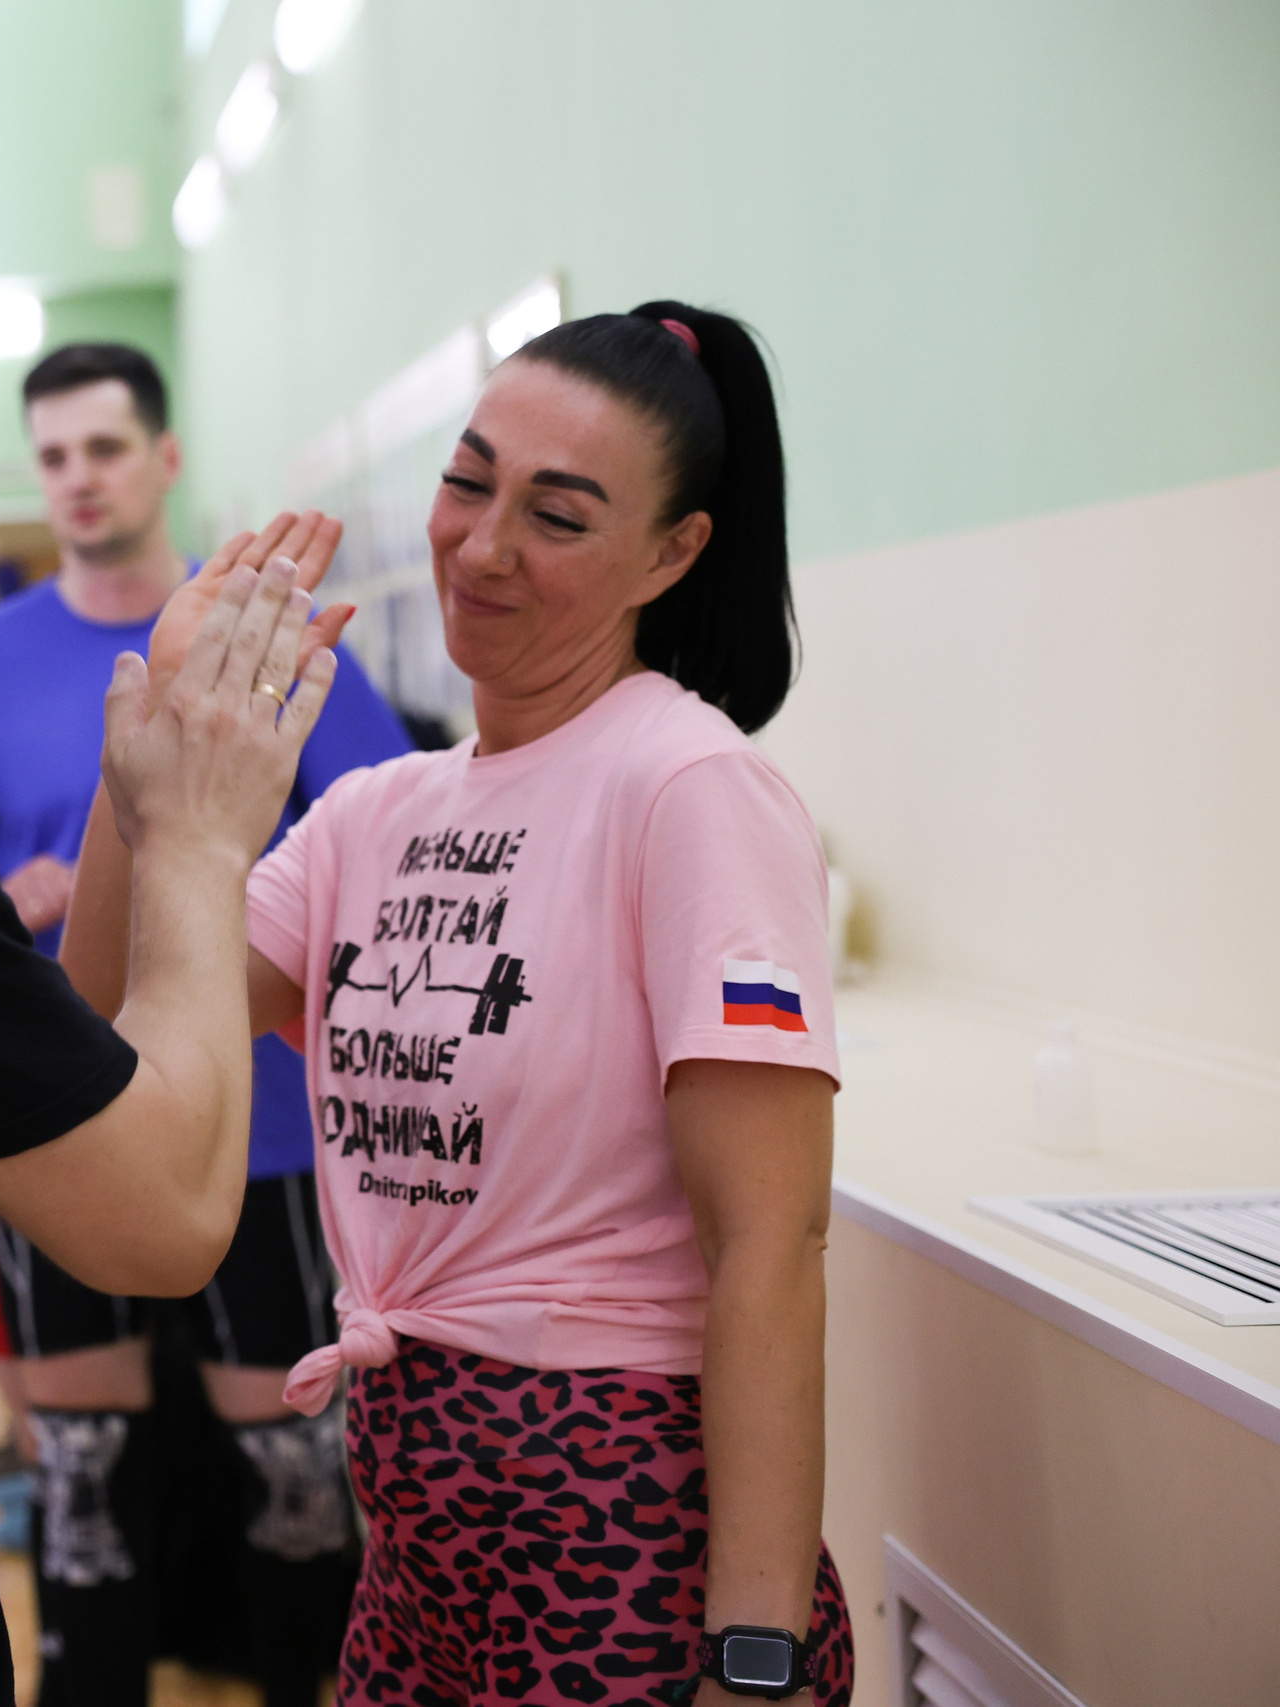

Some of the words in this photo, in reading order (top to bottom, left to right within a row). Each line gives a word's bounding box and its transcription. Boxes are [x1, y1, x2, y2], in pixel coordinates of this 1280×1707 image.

[373, 886, 509, 945] БОЛТАЙ
[329, 1026, 461, 1085] БОЛЬШЕ
[318, 1096, 484, 1165] ОДНИМАЙ
